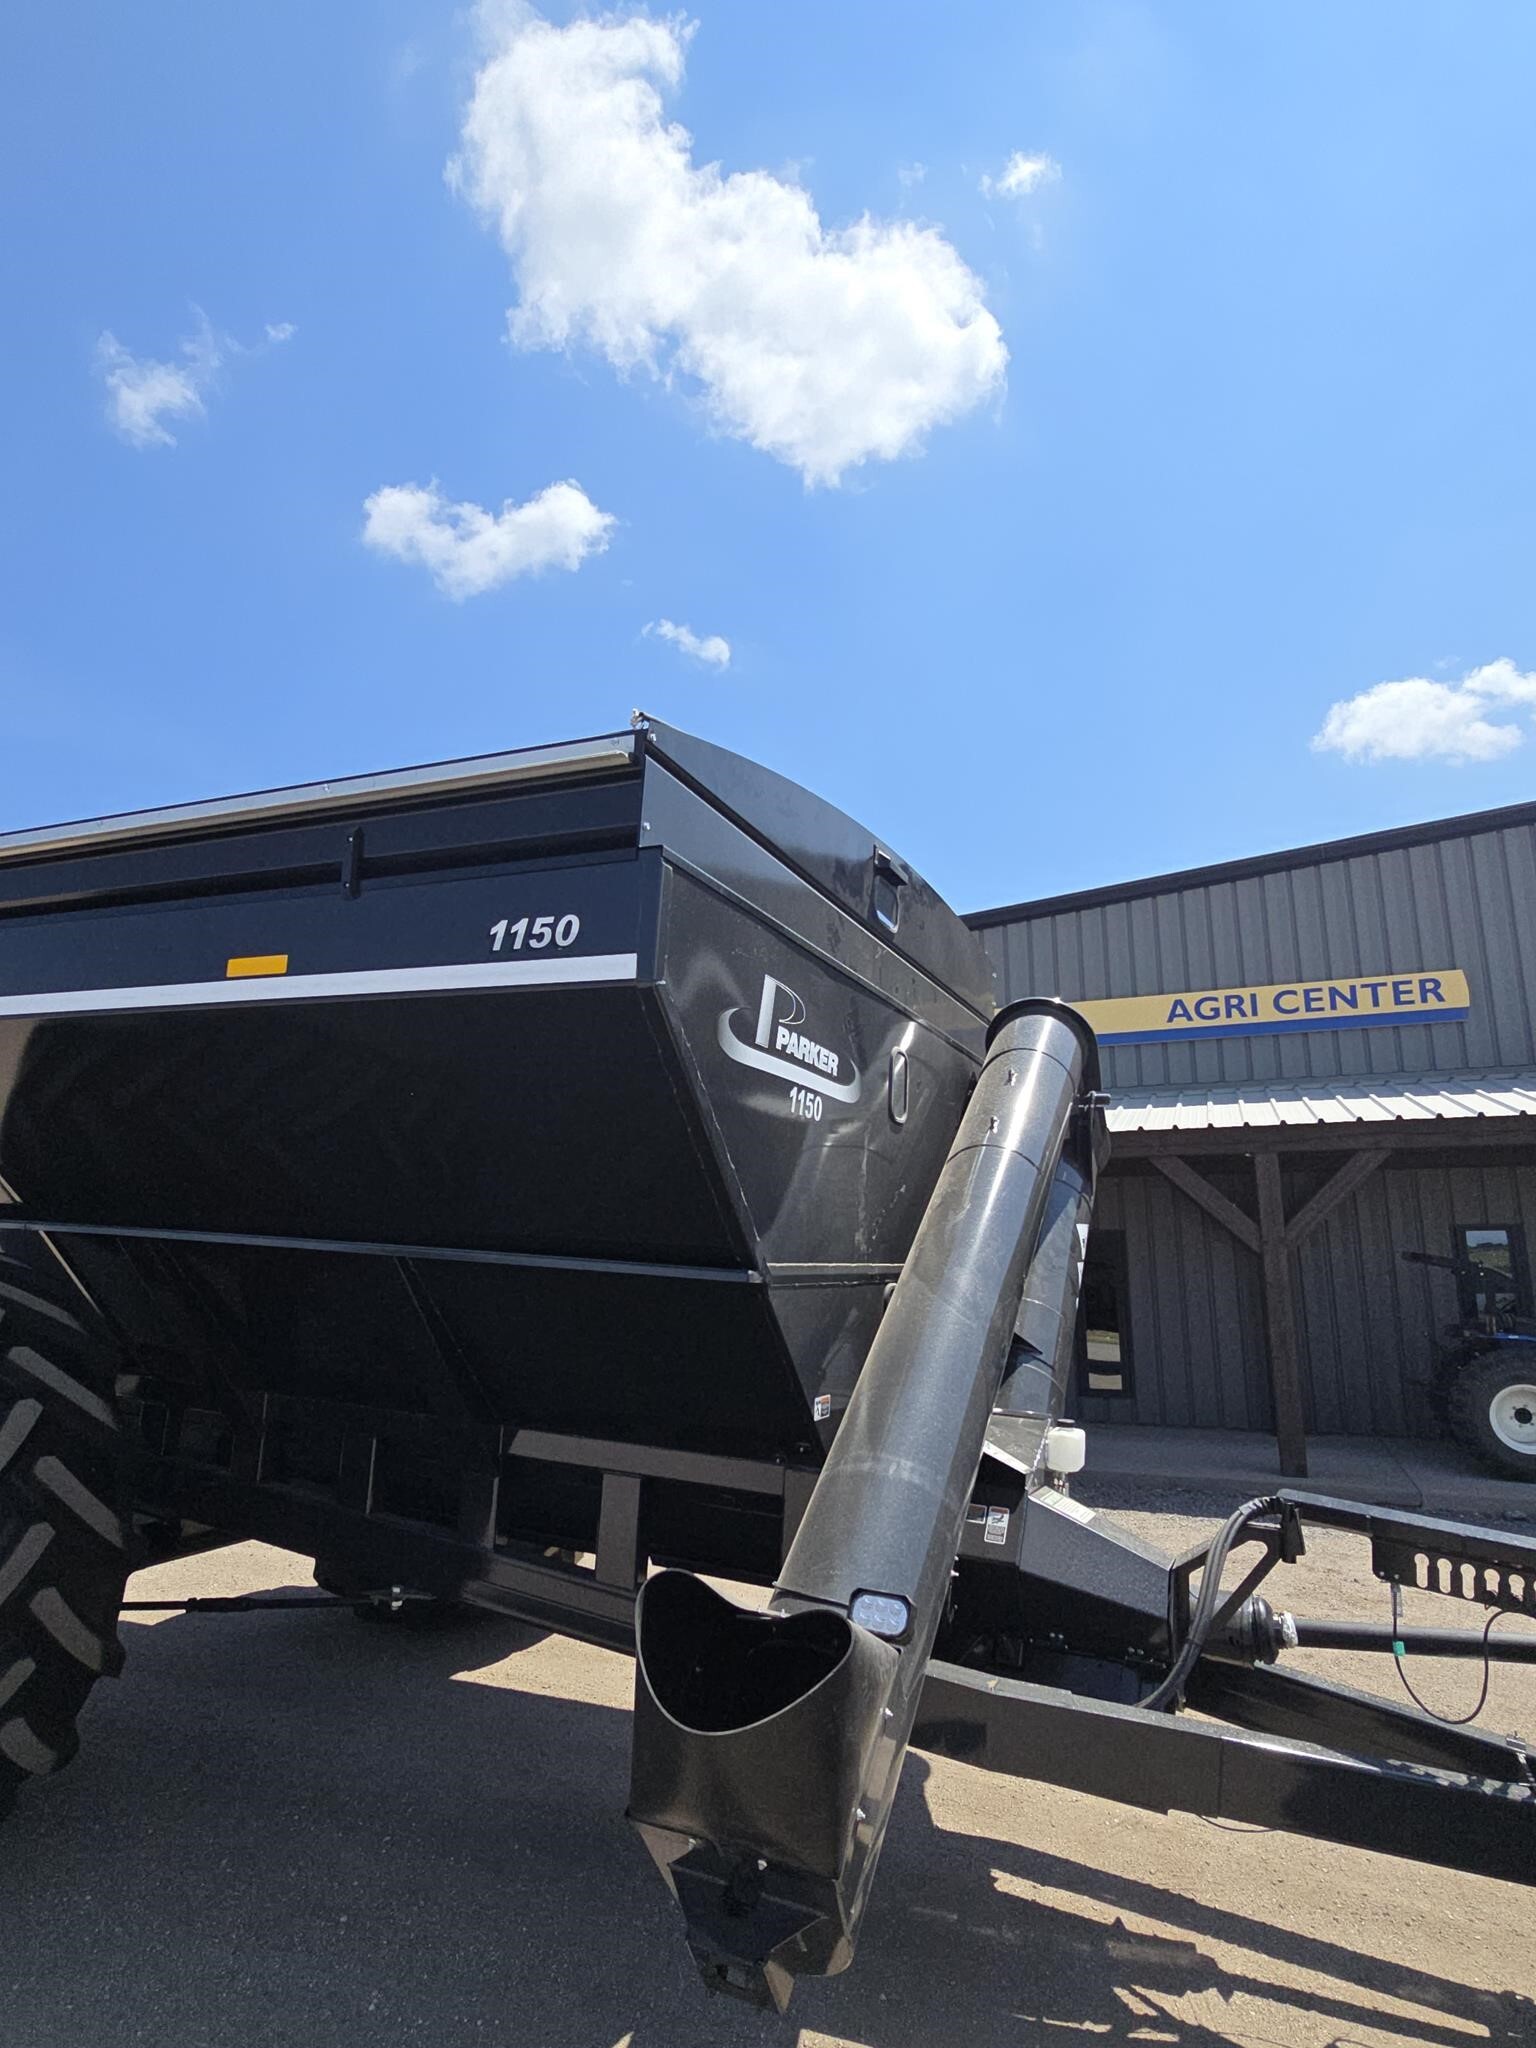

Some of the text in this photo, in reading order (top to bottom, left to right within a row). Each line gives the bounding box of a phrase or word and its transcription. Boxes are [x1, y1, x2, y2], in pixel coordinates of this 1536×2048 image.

[489, 914, 580, 951] 1150
[1166, 977, 1446, 1023] AGRI CENTER
[775, 1025, 839, 1077] PARKER
[789, 1086, 823, 1122] 1150
